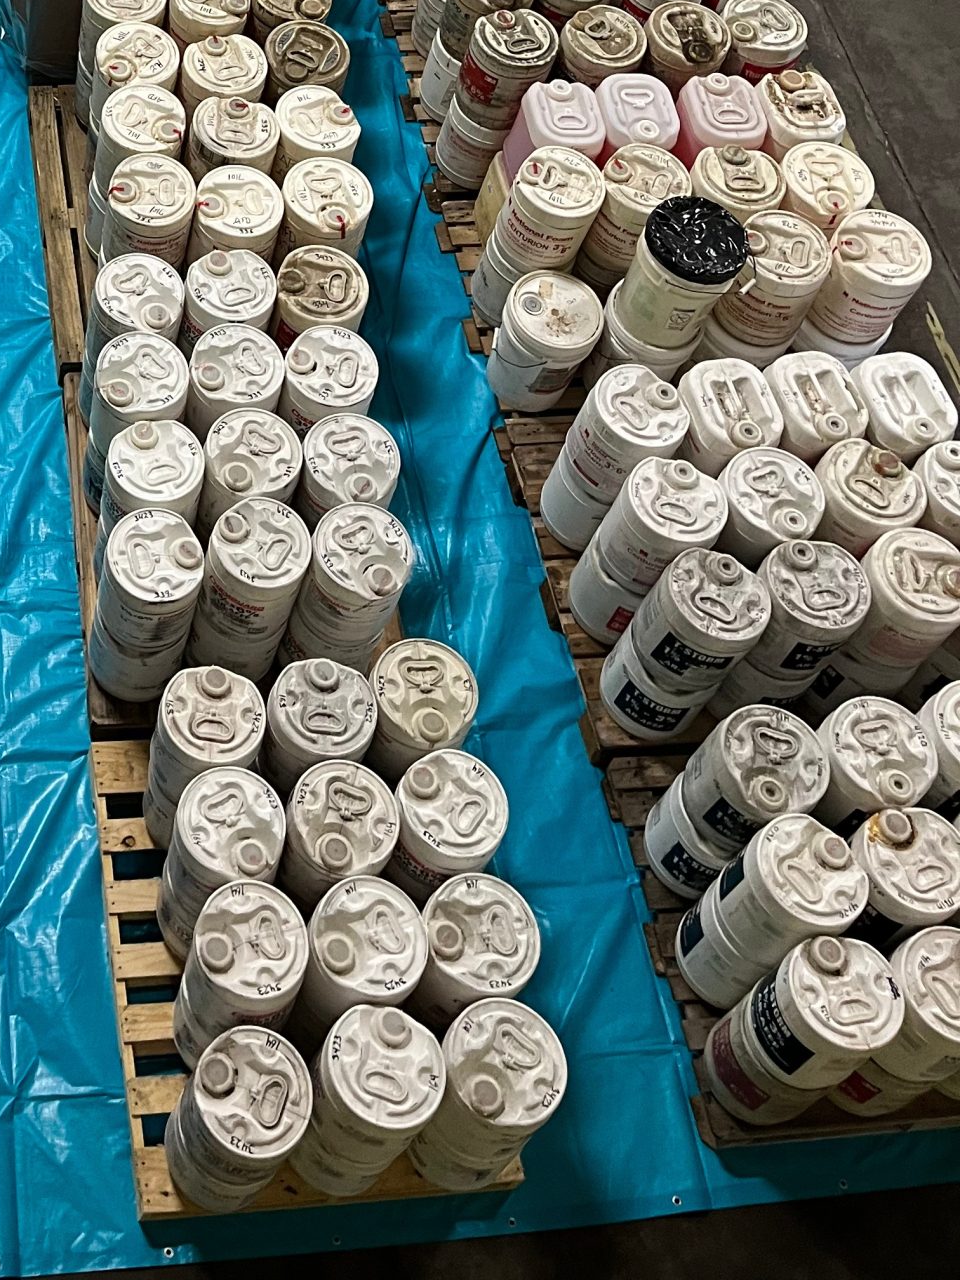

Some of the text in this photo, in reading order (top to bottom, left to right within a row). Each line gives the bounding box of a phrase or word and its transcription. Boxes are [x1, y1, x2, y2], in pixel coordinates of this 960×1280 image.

[512, 208, 545, 241] National
[134, 511, 154, 522] 3423
[674, 641, 726, 664] T-STORM
[634, 688, 682, 715] T-STORM
